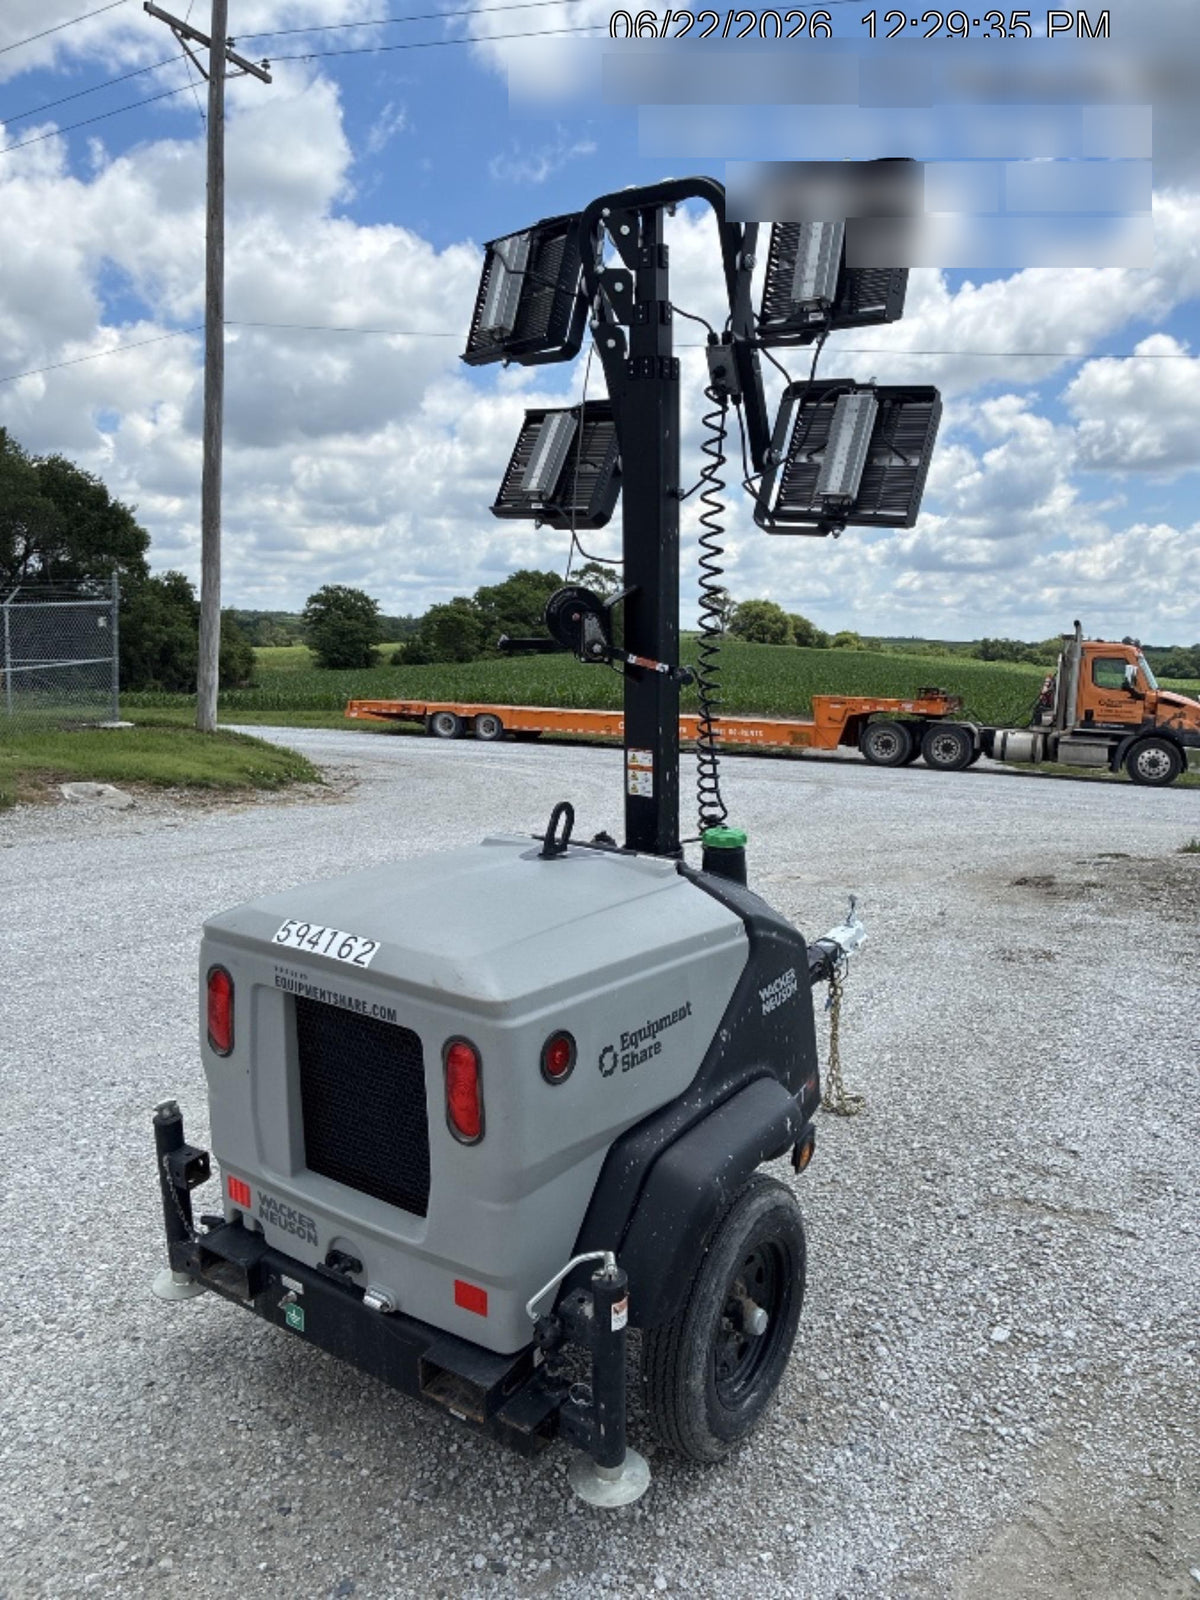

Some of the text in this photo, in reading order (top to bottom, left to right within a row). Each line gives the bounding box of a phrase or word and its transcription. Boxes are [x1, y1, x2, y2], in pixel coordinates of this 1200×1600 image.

[276, 920, 376, 965] 594162
[274, 975, 398, 1022] EQUIPMENTSHARE.COM
[758, 967, 796, 1001] WACKER
[761, 980, 798, 1016] NEUSON
[619, 1000, 693, 1051] Equipment
[620, 1040, 662, 1073] Share
[257, 1190, 317, 1233] WACKER
[258, 1207, 318, 1247] NEUSON
